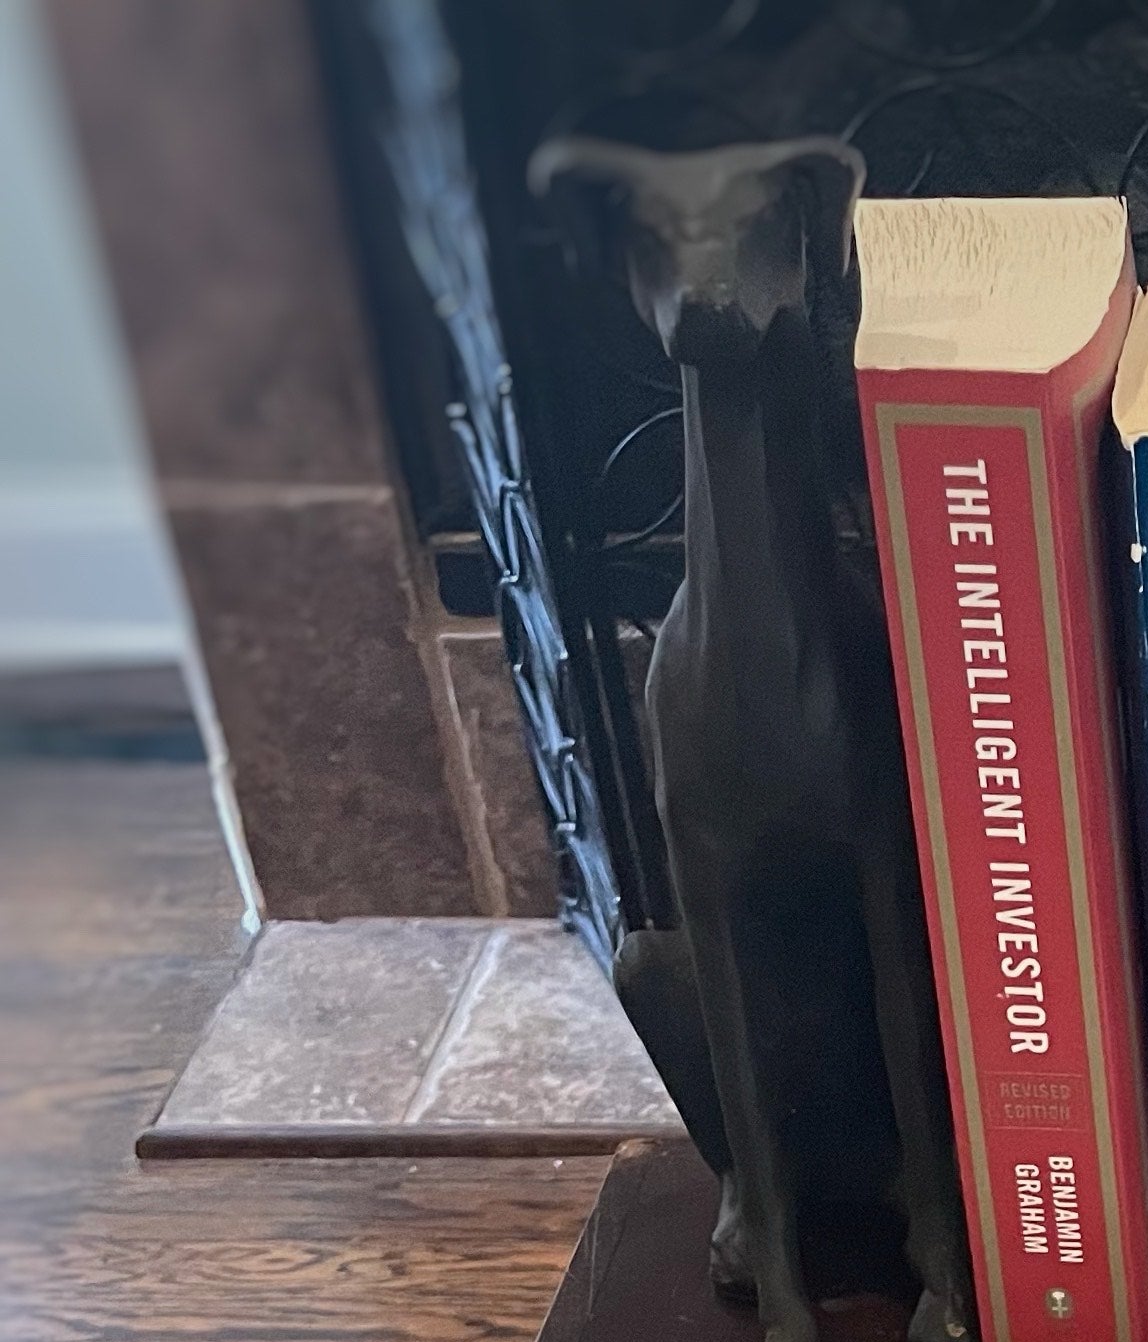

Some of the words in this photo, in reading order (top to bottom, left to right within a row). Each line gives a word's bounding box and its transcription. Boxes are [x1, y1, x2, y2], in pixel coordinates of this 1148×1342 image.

[943, 459, 993, 546] THE
[954, 563, 1027, 844] INTELLIGENT
[989, 863, 1049, 1055] INVESTOR
[1000, 1082, 1071, 1100] REVISED
[1004, 1104, 1070, 1121] EDITION
[1015, 1163, 1048, 1255] GRAHAM
[1048, 1156, 1083, 1264] BENJAMIN
